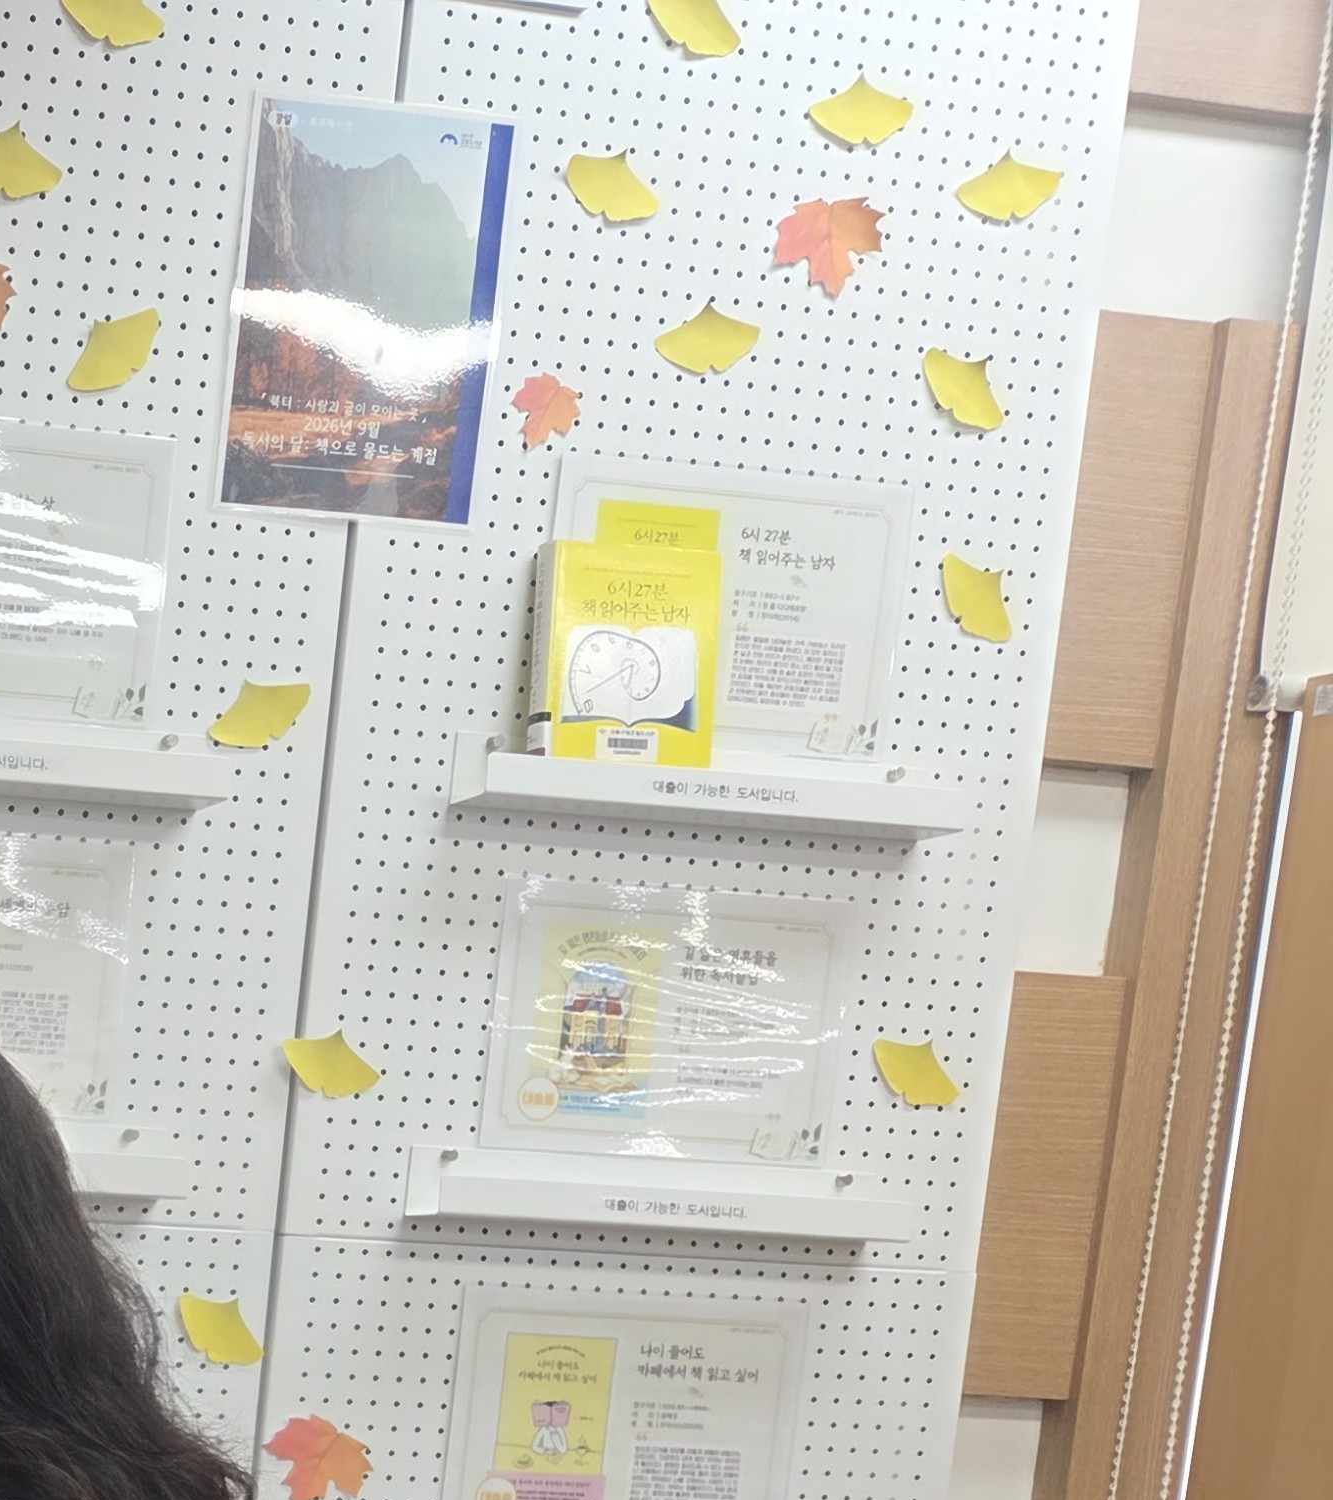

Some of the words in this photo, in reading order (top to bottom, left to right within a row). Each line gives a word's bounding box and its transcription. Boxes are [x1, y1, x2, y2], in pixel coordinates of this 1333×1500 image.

[303, 416, 353, 436] 2026년
[357, 420, 381, 439] 9월
[242, 431, 284, 450] 독서의
[314, 438, 357, 457] 책으로
[362, 441, 405, 462] 물드는
[410, 446, 438, 466] 계절
[634, 529, 653, 543] 6시
[741, 527, 761, 542] 6시
[764, 529, 792, 546] 27분
[738, 548, 752, 563] 책
[756, 550, 806, 569] 읽어주는
[811, 555, 836, 571] 남자
[607, 581, 631, 596] 6시
[635, 583, 669, 601] 27분
[582, 600, 596, 616] 책
[600, 601, 659, 619] 읽어주는
[662, 605, 691, 624] 남자
[653, 780, 688, 795] 대출이
[694, 783, 731, 799] 가능한
[737, 785, 799, 803] 도서입니다.
[680, 967, 706, 982] 위한
[605, 1198, 639, 1213] 대출이
[645, 1200, 681, 1216] 가능한
[687, 1202, 748, 1220] 도서입니다.
[640, 1343, 664, 1358] 나이
[668, 1345, 705, 1360] 들어도
[637, 1363, 687, 1379] 카페에서
[690, 1366, 703, 1381] 책
[707, 1367, 731, 1382] 읽고
